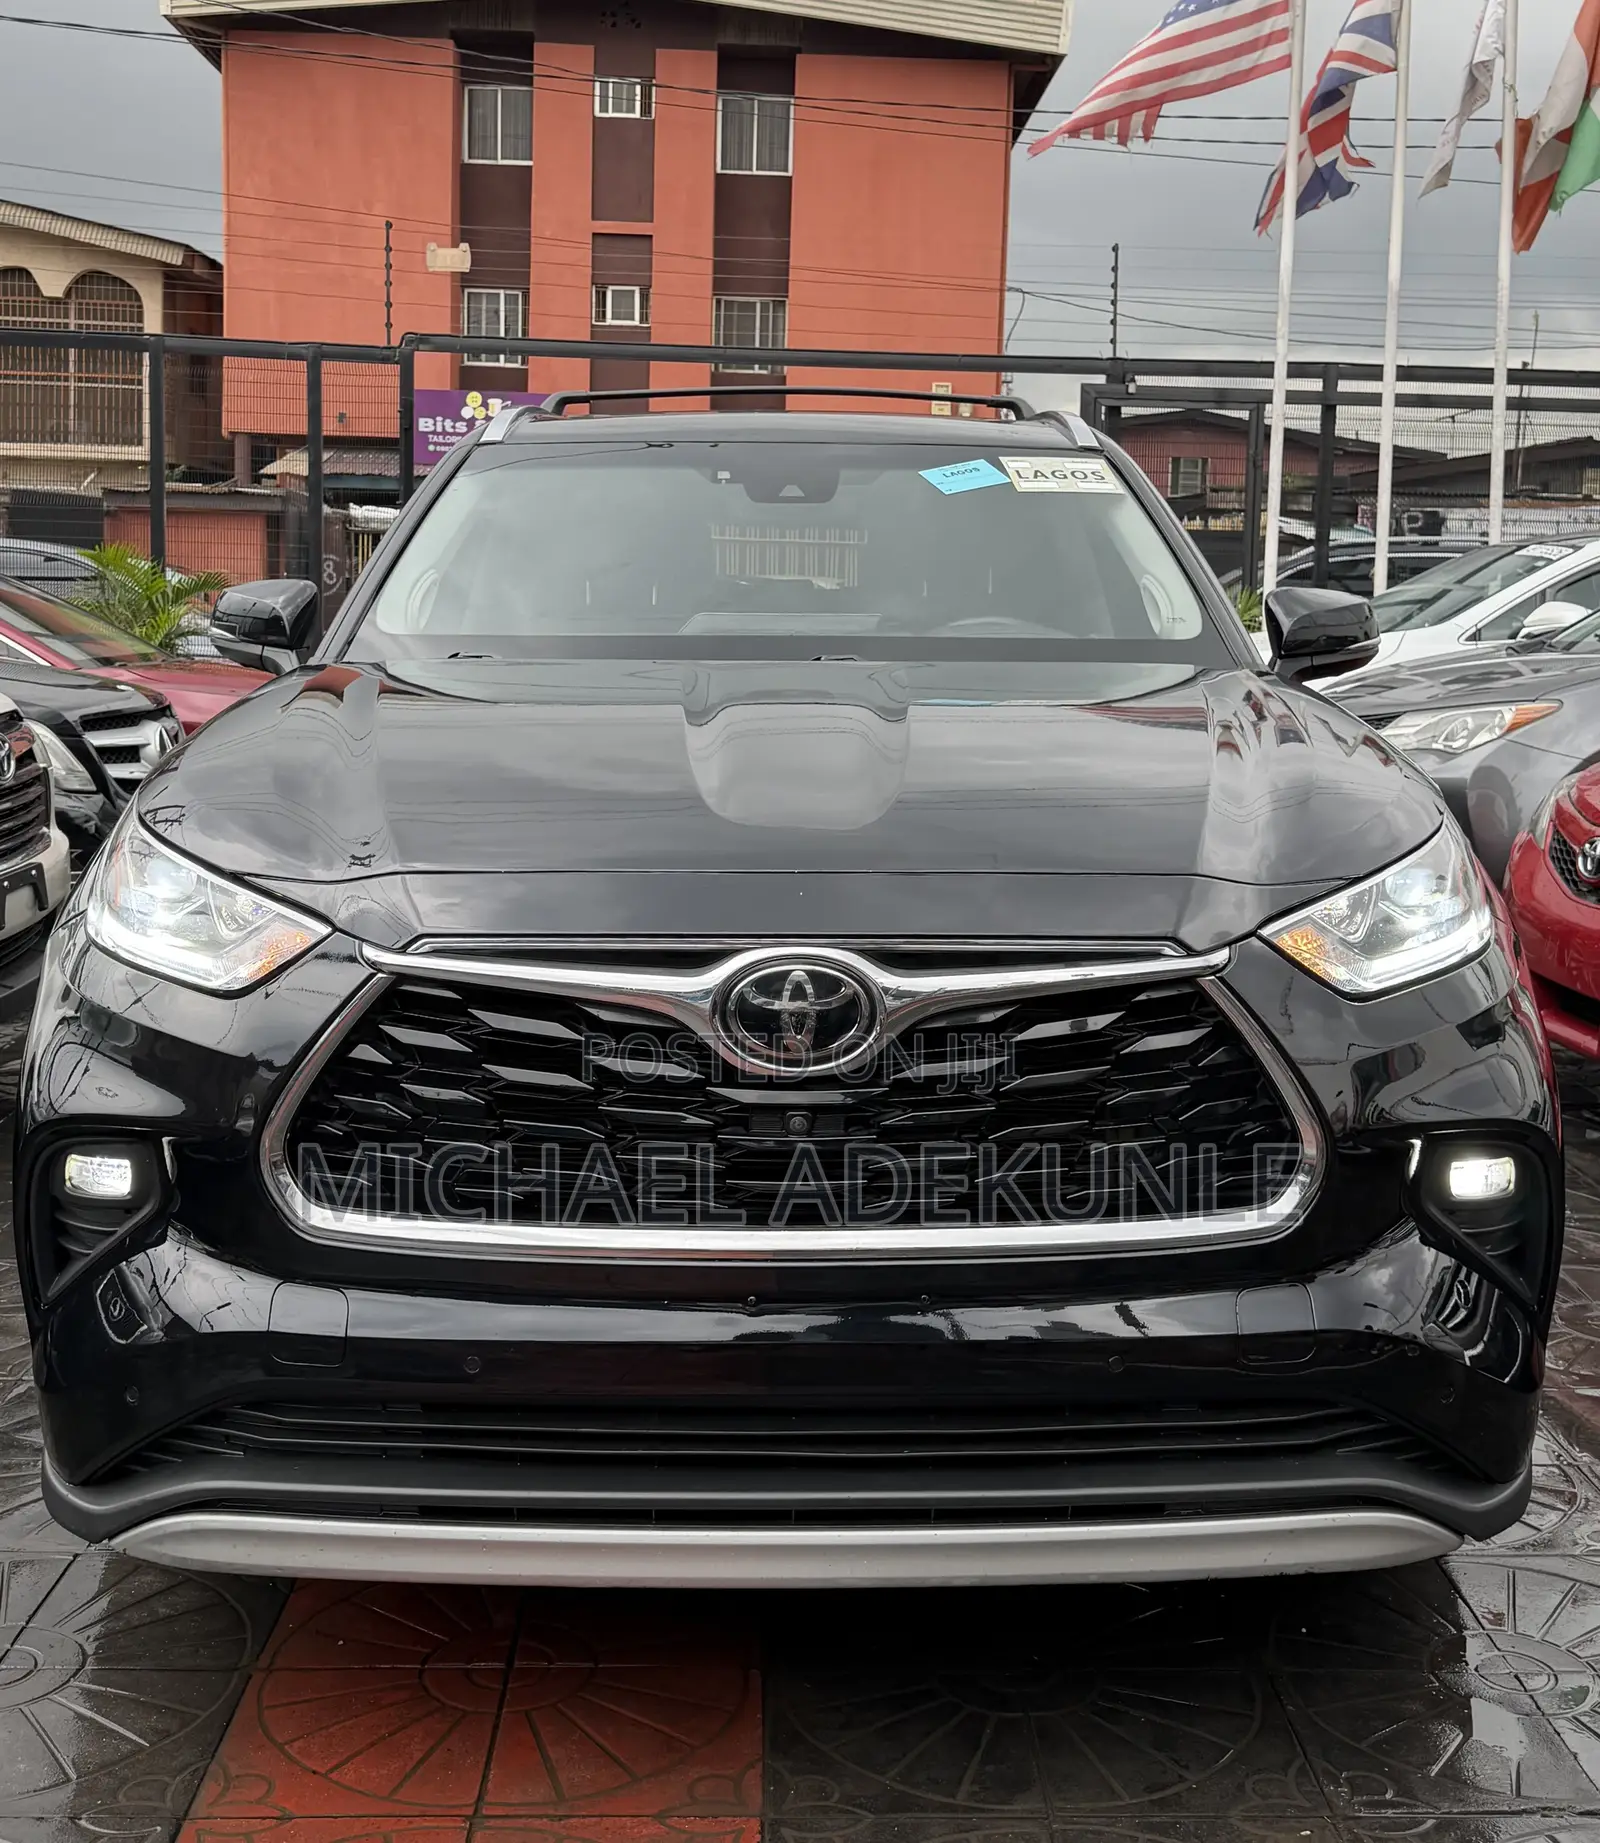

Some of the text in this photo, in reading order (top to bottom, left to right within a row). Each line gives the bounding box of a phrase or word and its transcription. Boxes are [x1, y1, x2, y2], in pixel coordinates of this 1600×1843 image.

[418, 416, 468, 433] Bits
[942, 466, 981, 478] LAGOS
[1014, 469, 1107, 482] LAGOS
